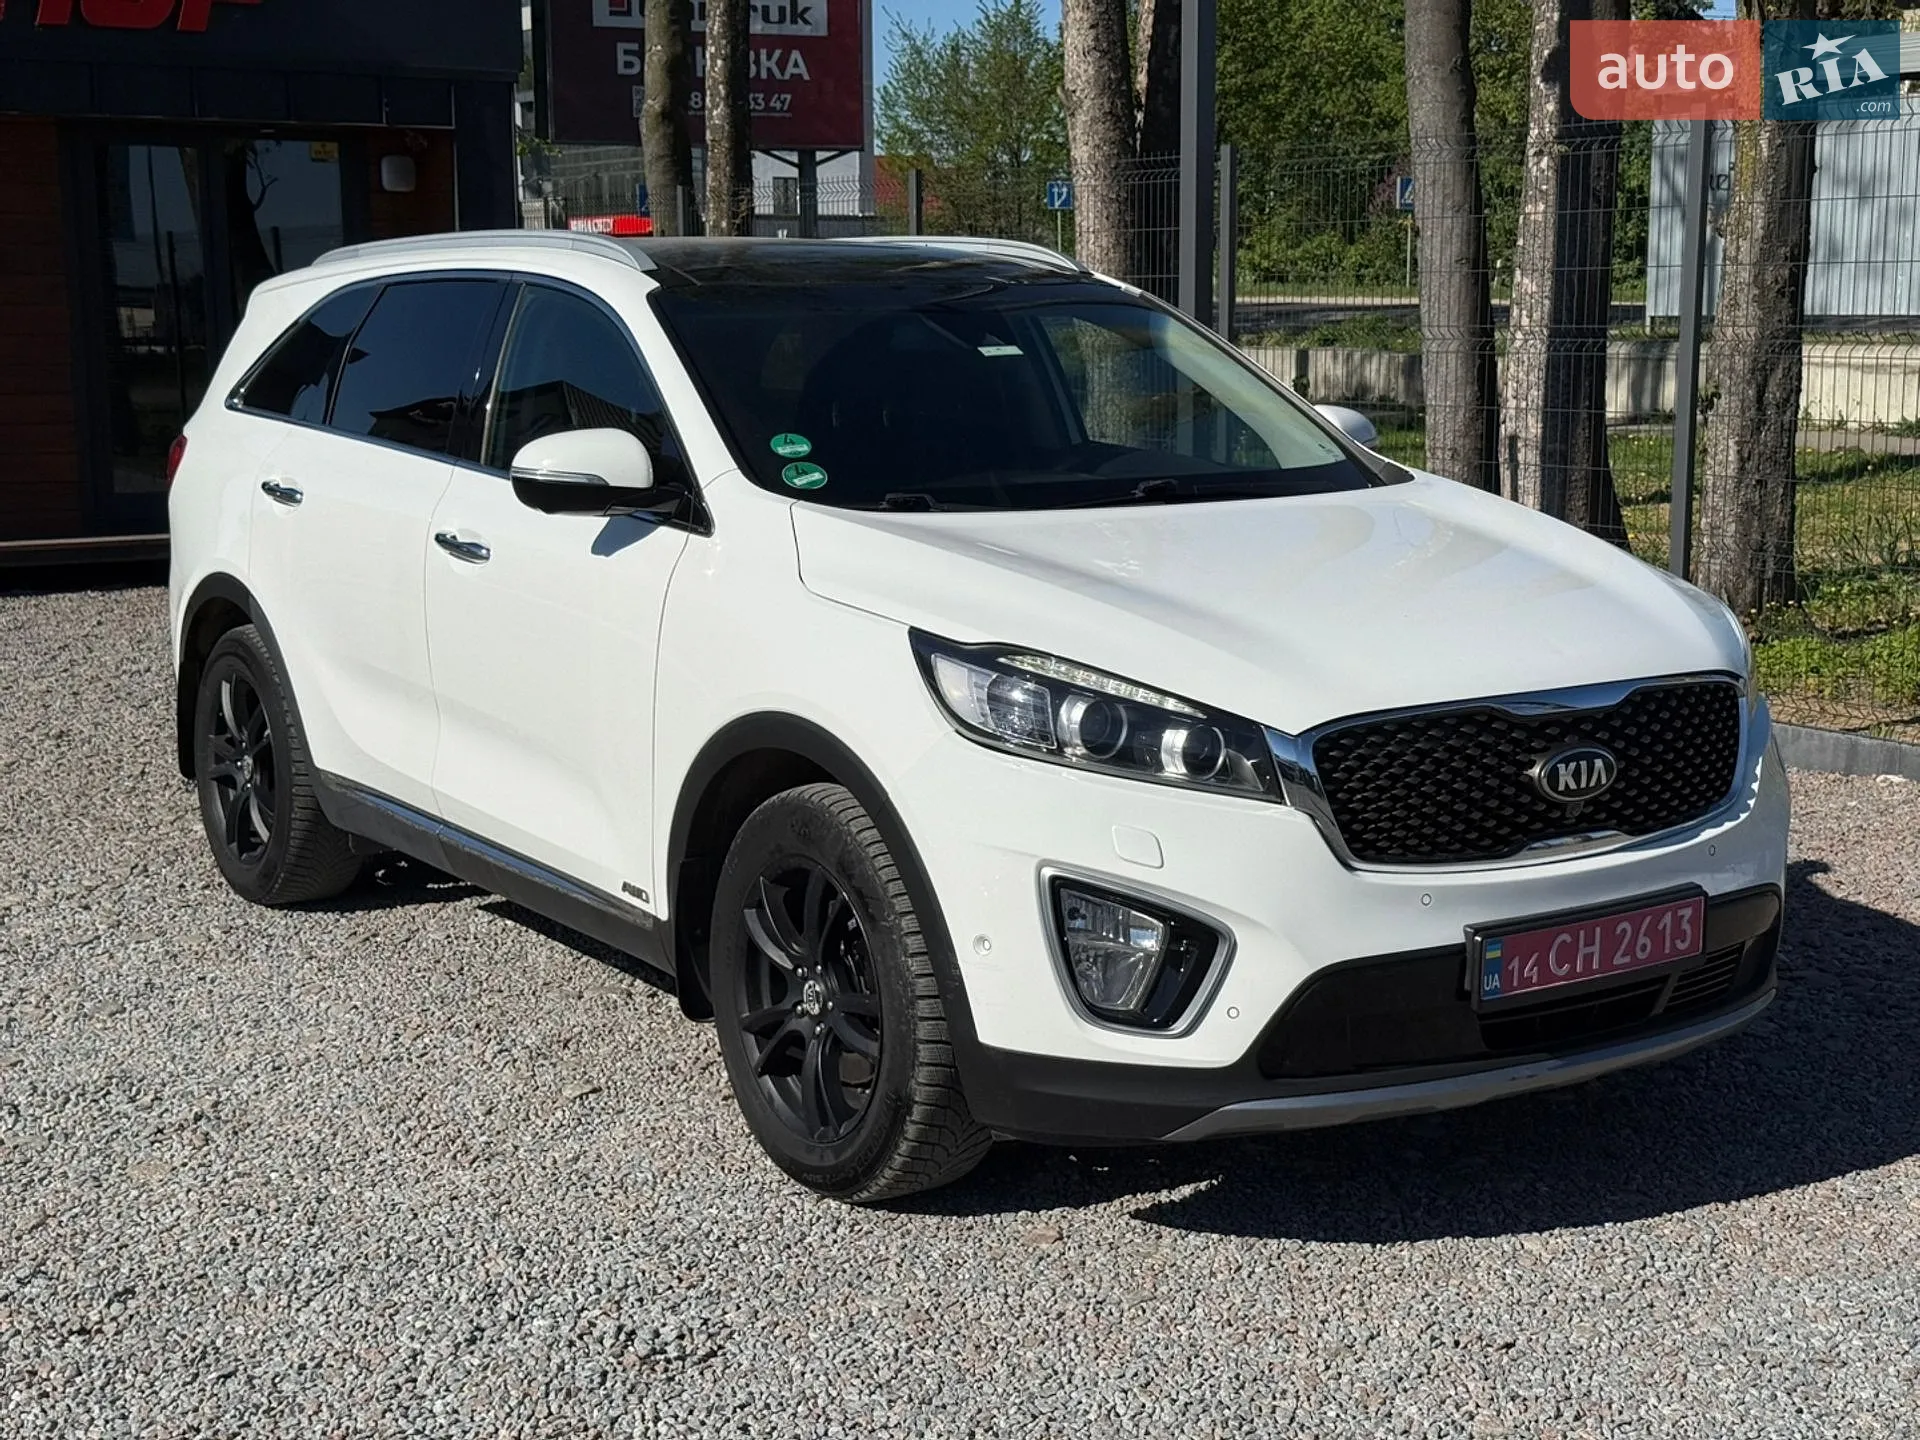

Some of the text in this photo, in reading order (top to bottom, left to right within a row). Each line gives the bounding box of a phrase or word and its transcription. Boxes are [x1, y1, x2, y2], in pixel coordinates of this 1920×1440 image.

[769, 94, 792, 112] 47
[1557, 758, 1607, 792] KIA
[1507, 906, 1694, 987] 14 CH 2613
[1483, 973, 1501, 991] UA
